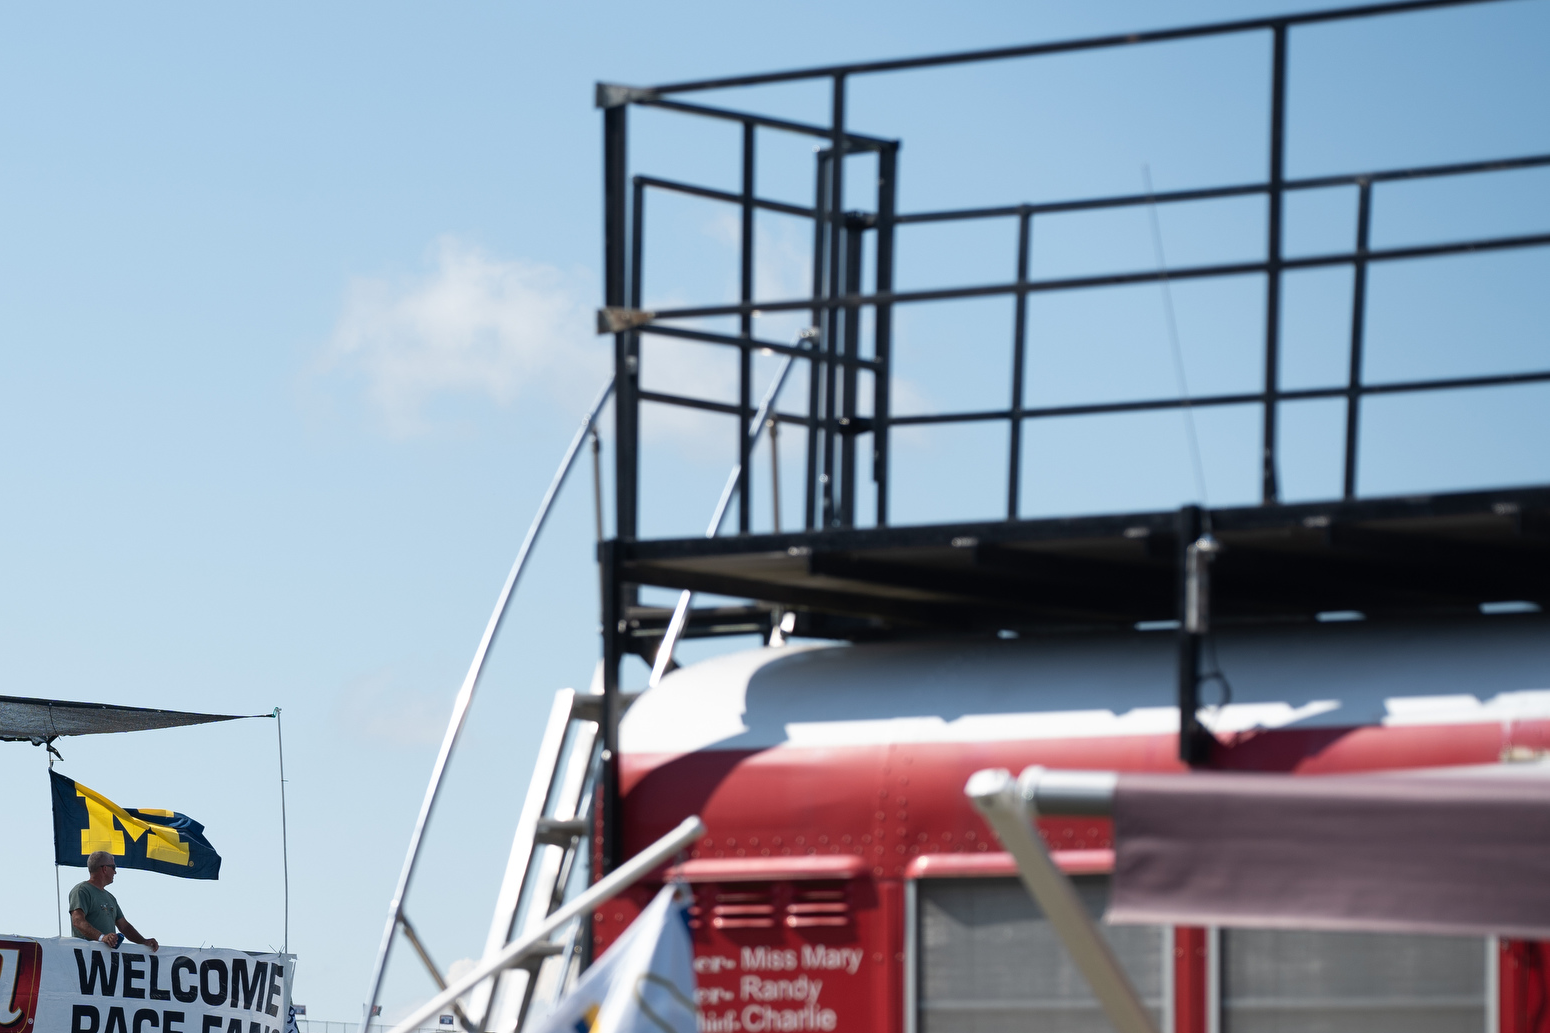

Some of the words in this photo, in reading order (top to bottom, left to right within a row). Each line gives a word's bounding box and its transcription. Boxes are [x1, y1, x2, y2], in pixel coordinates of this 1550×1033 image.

[740, 946, 798, 971] Miss
[801, 944, 864, 975] Mary
[73, 948, 284, 1017] WELCOME
[740, 974, 823, 1004] Randy
[741, 1003, 837, 1032] Charlie
